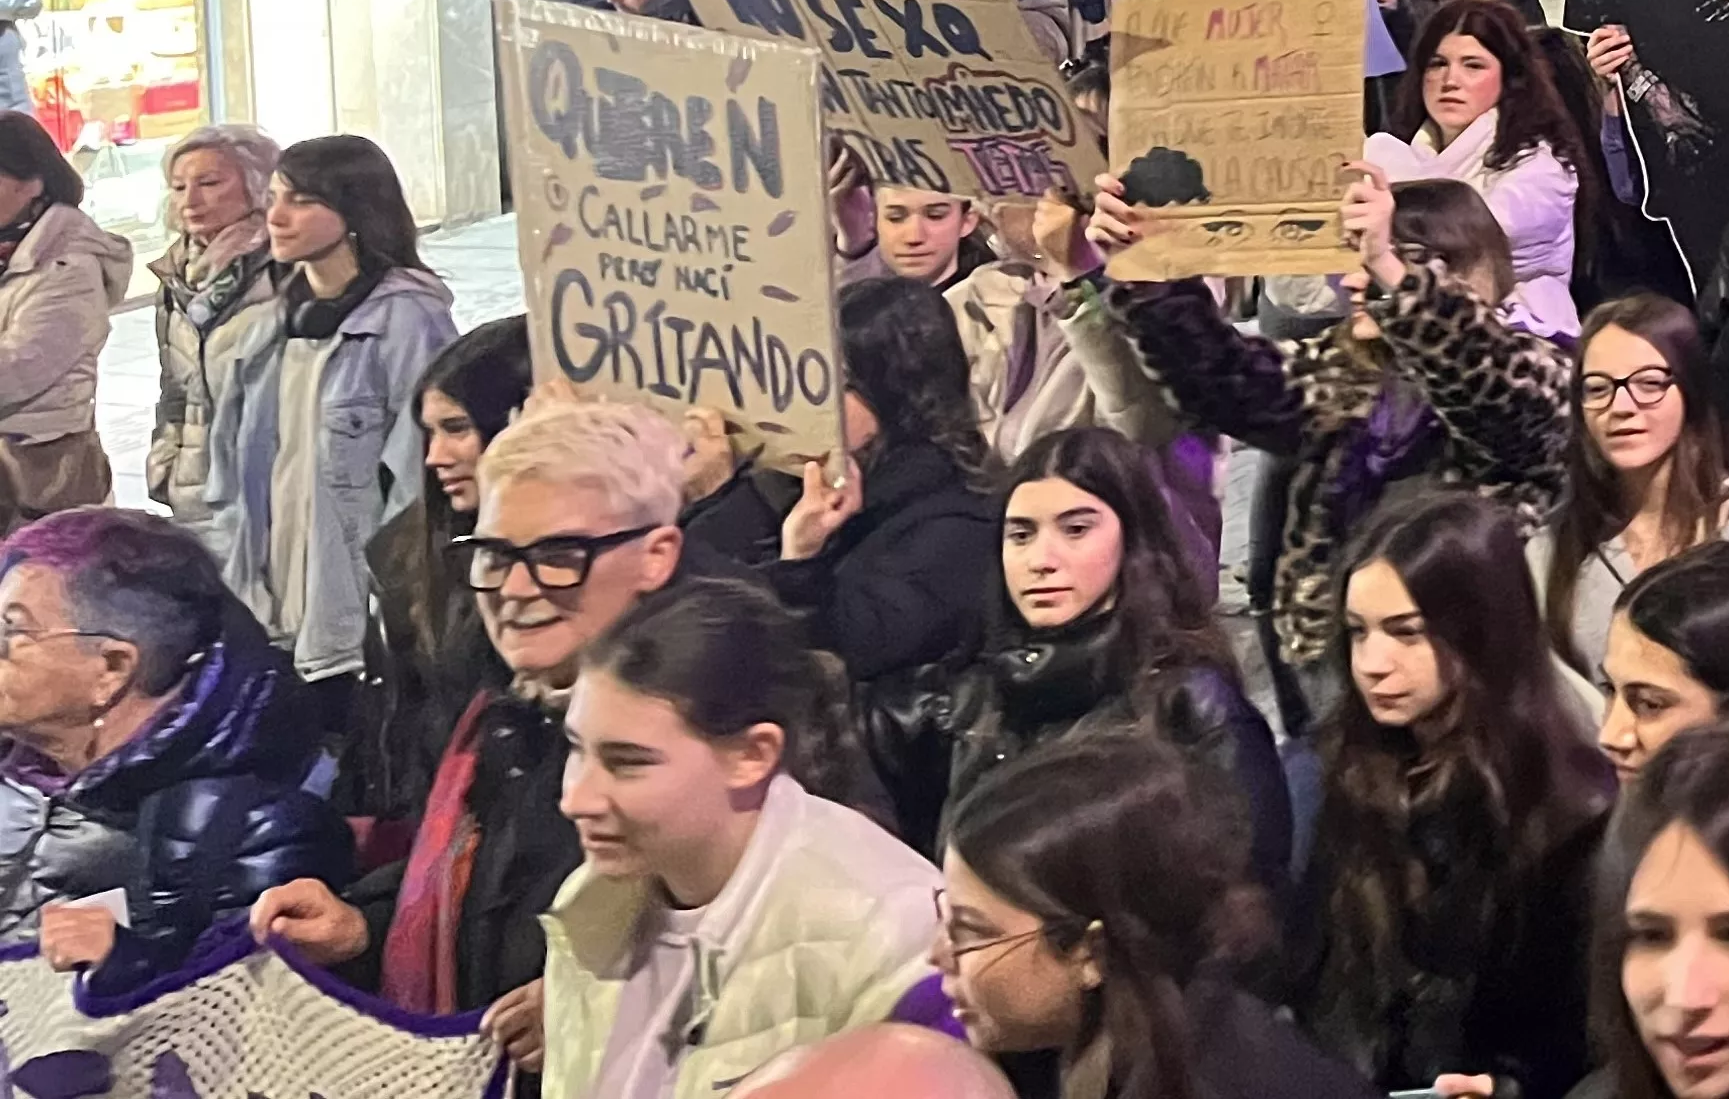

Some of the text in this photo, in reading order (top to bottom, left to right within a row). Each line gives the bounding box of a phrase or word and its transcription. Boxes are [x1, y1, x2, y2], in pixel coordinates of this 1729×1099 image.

[1204, 0, 1289, 44] MUJER
[837, 67, 938, 121] TANTO
[932, 70, 1063, 134] MIEDO
